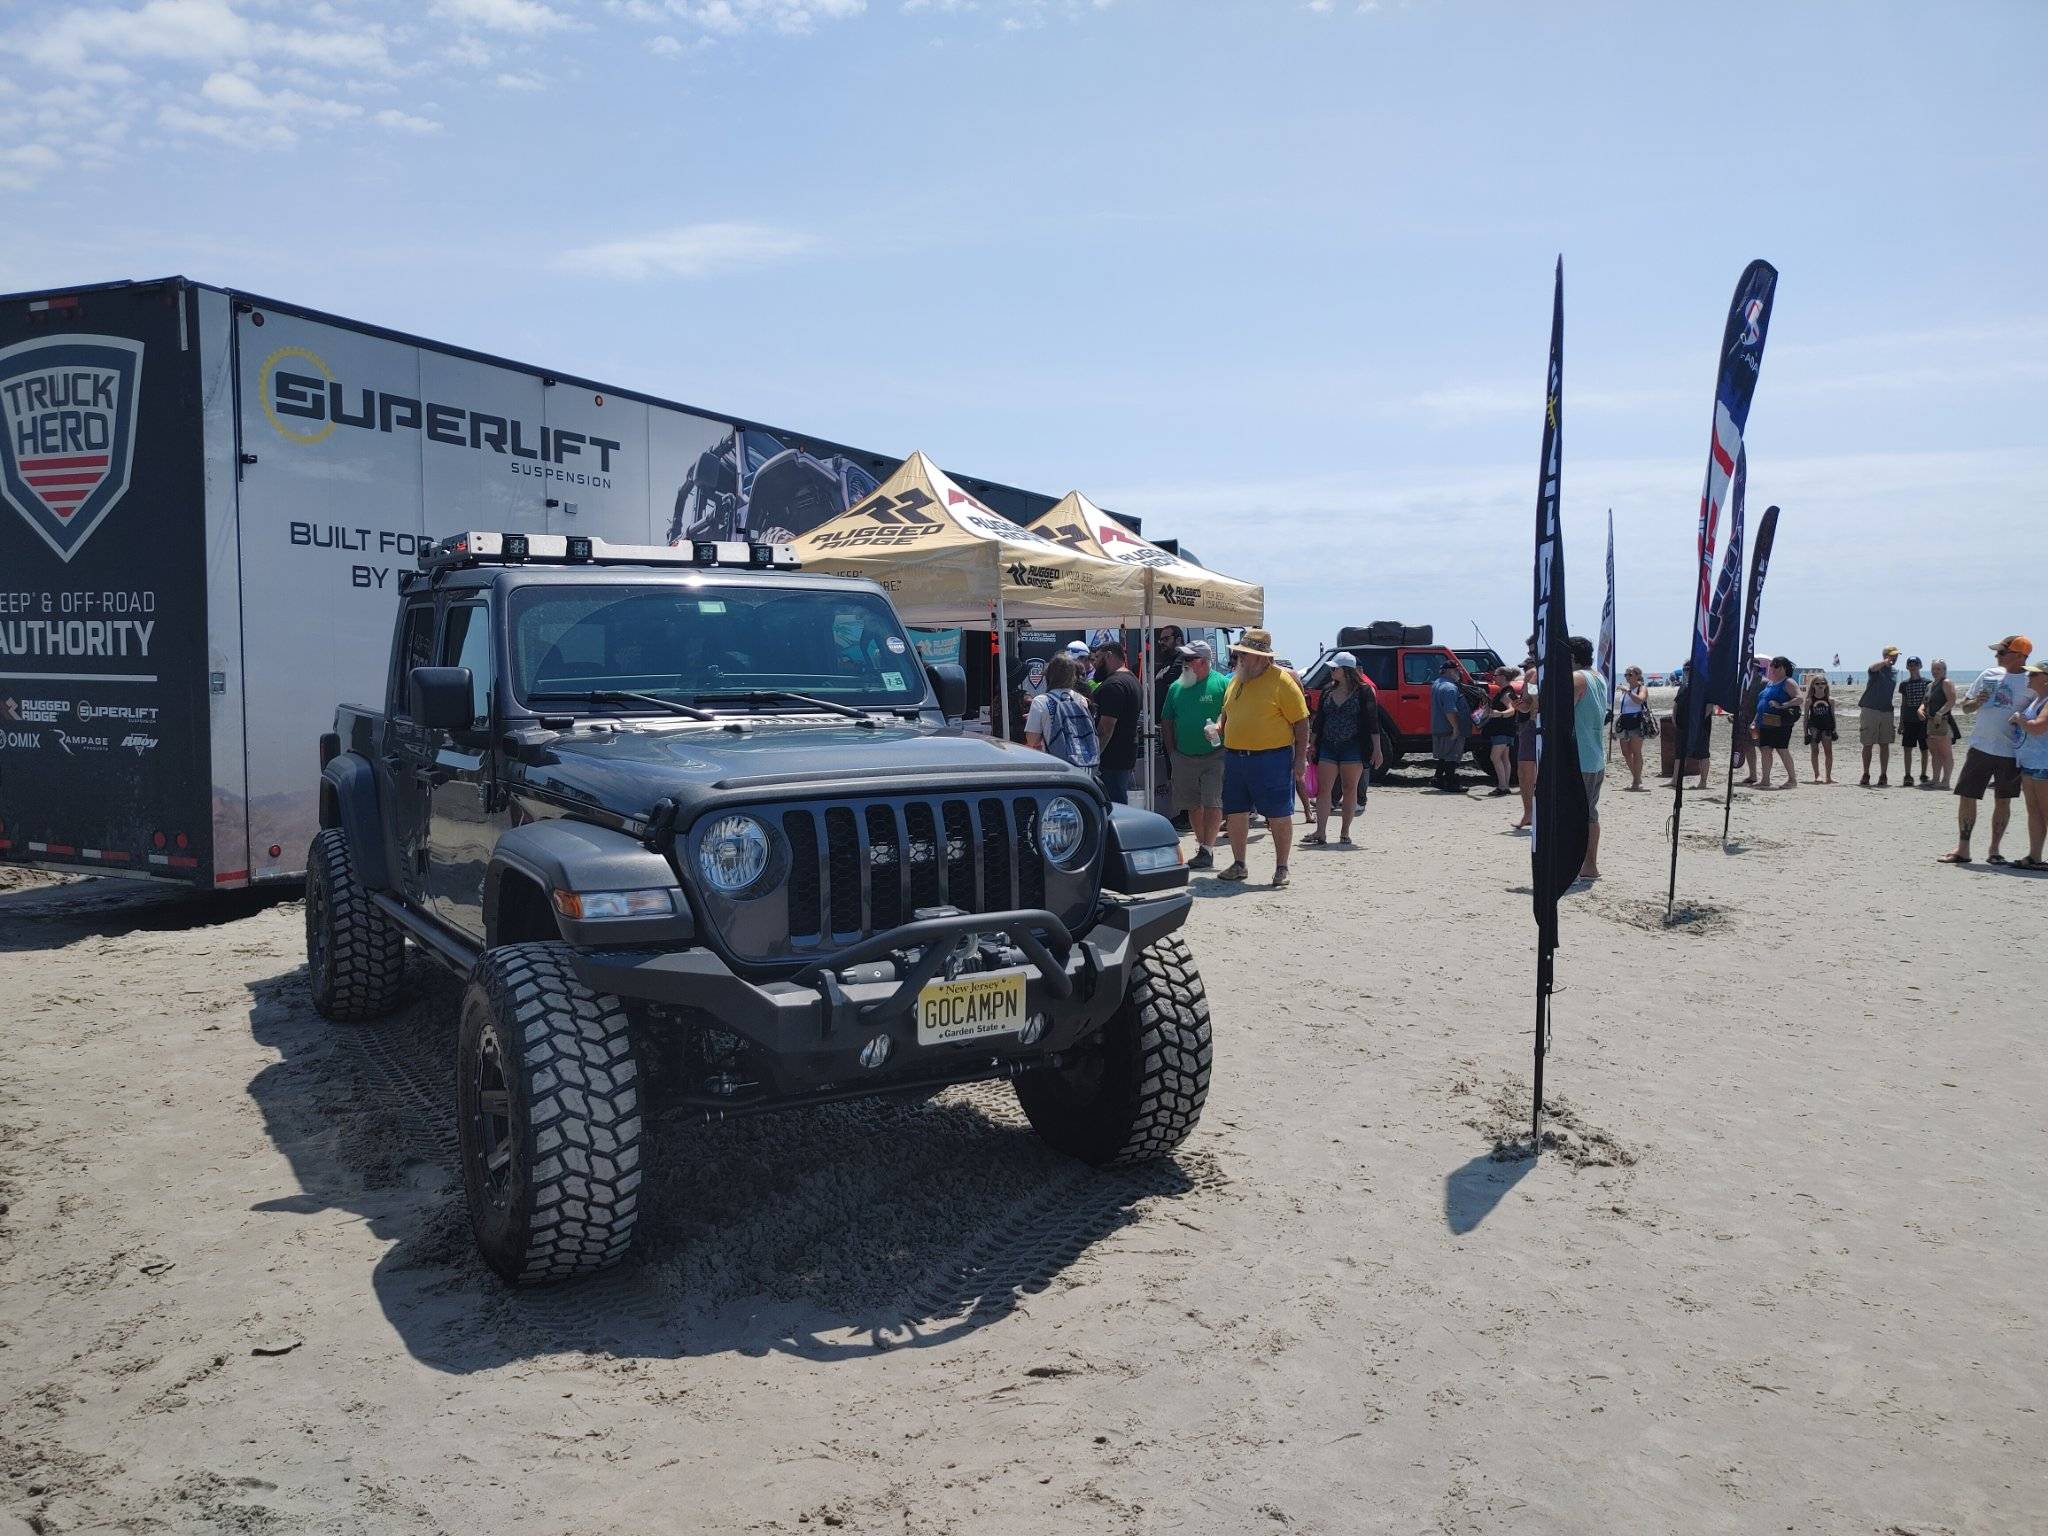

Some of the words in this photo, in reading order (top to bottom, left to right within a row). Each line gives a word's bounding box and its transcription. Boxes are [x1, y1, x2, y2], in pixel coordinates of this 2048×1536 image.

[4, 372, 116, 416] TRUCK
[17, 410, 110, 455] HERO
[275, 370, 621, 473] SUPERLIFT
[511, 462, 612, 489] SUSPENSION
[289, 521, 372, 551] BUILT
[809, 523, 946, 545] RUGGED
[816, 536, 918, 551] RIDGE
[352, 565, 389, 588] BY
[1027, 576, 1053, 590] RIDGE
[1028, 565, 1060, 579] RUGGED
[41, 592, 52, 612] &
[61, 591, 156, 613] OFF-ROAD
[1175, 586, 1201, 598] RUGGED
[1175, 597, 1196, 607] RIDGE
[21, 699, 71, 712] RUGGED
[79, 705, 159, 719] SUPERLIFT
[22, 711, 58, 722] RIDGE
[8, 732, 41, 748] OMIX
[50, 729, 109, 755] RAMPAGE
[946, 984, 969, 995] New
[970, 981, 999, 994] Jersey
[925, 989, 1018, 1029] GOCAMPN
[944, 1026, 974, 1039] Garden
[977, 1021, 999, 1033] State
